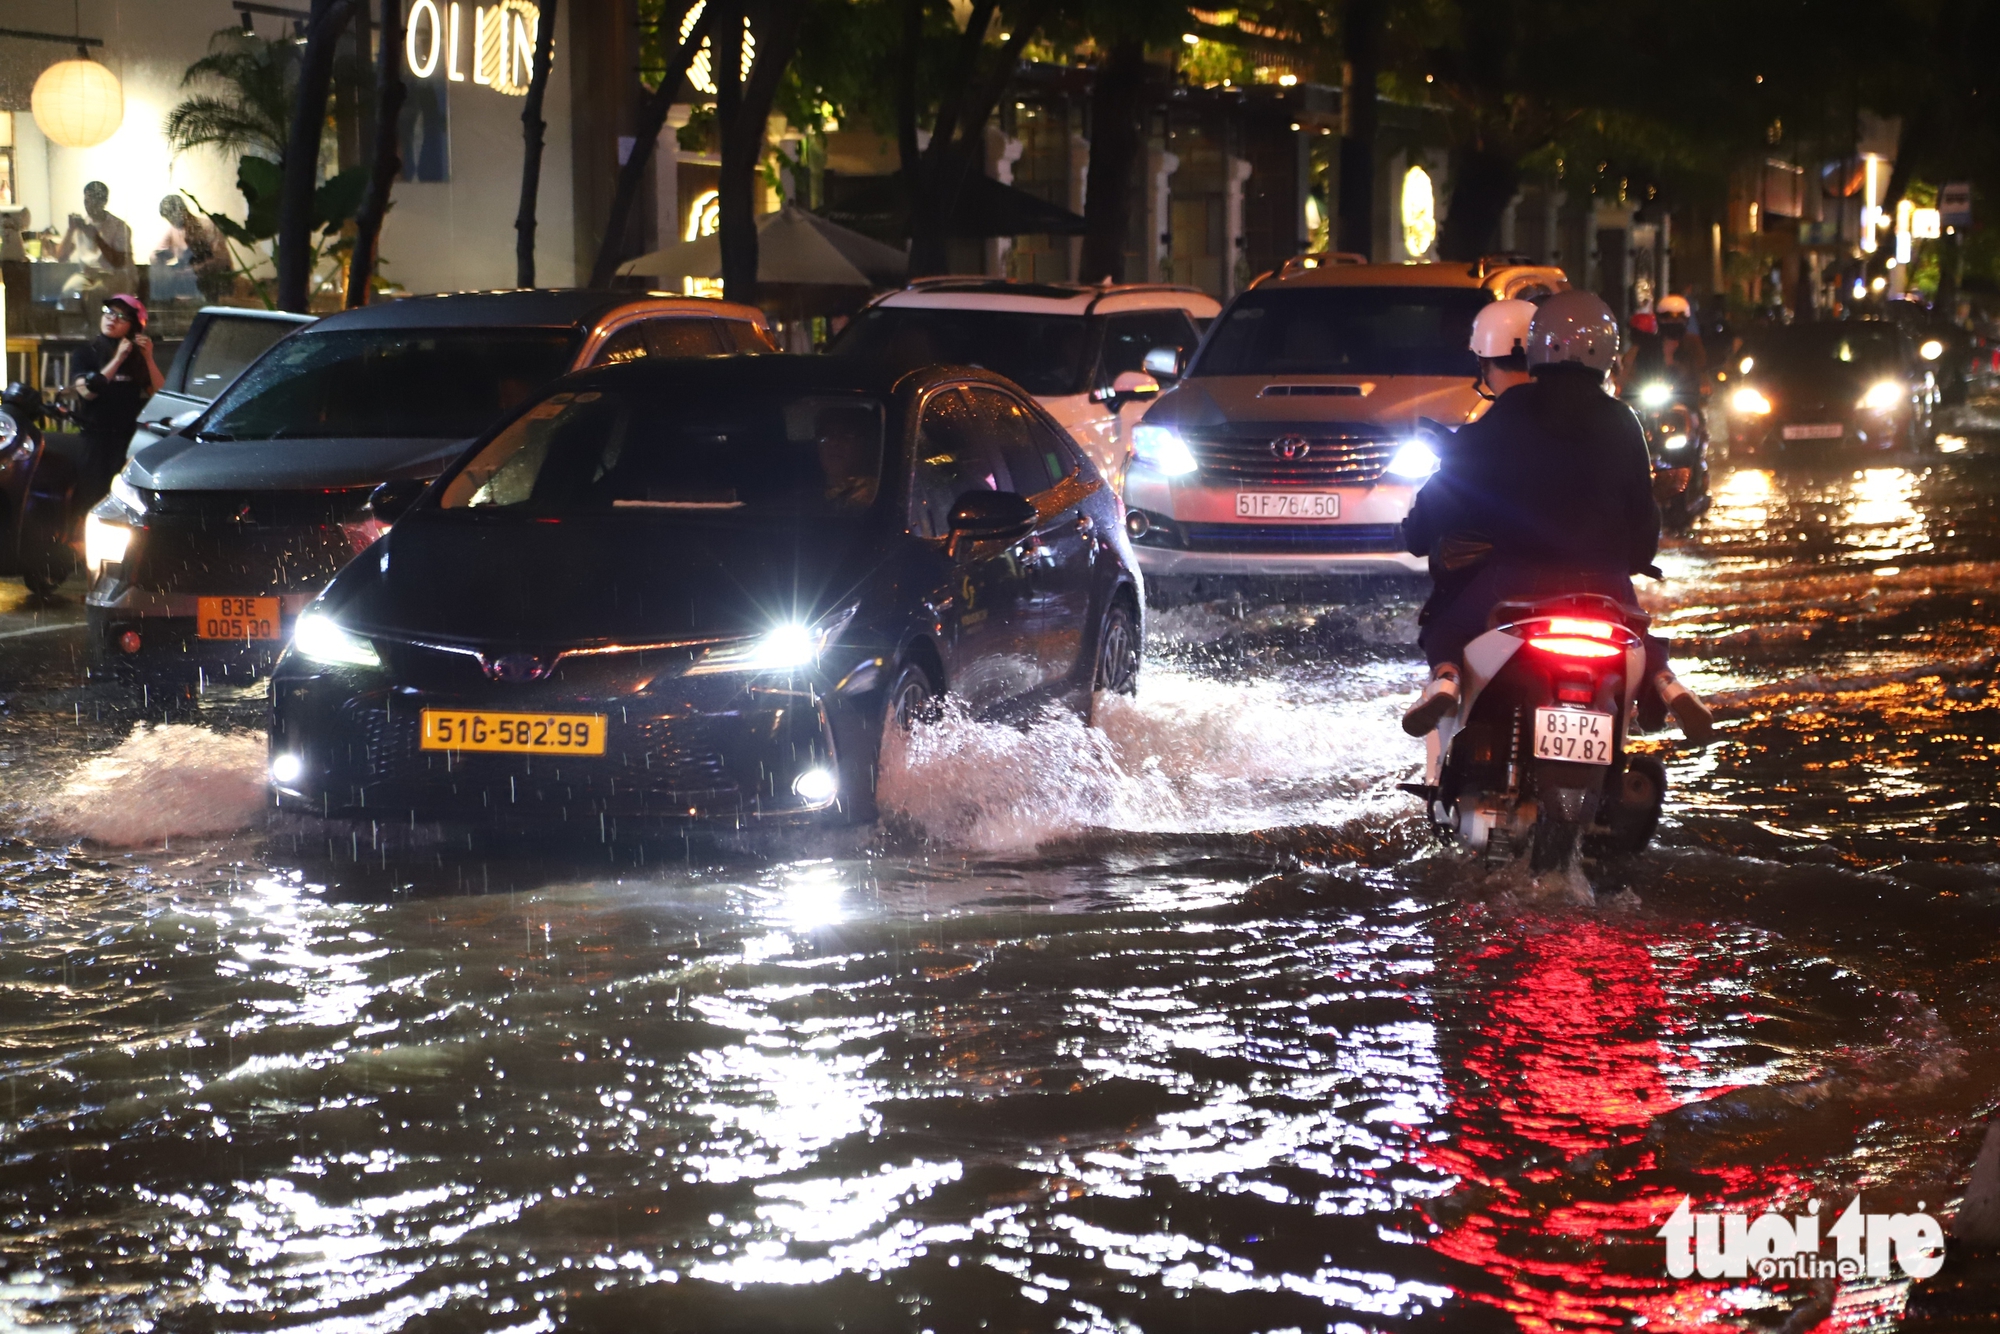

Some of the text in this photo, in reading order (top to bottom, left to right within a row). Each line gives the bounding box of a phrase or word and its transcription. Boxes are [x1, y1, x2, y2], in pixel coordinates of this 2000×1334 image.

[1240, 496, 1336, 515] 51F-764.50
[221, 599, 256, 617] 83E
[207, 619, 270, 637] 005.30
[438, 717, 589, 747] 51G-582.99
[1547, 713, 1599, 737] 83-P4
[1539, 735, 1607, 761] 497.82
